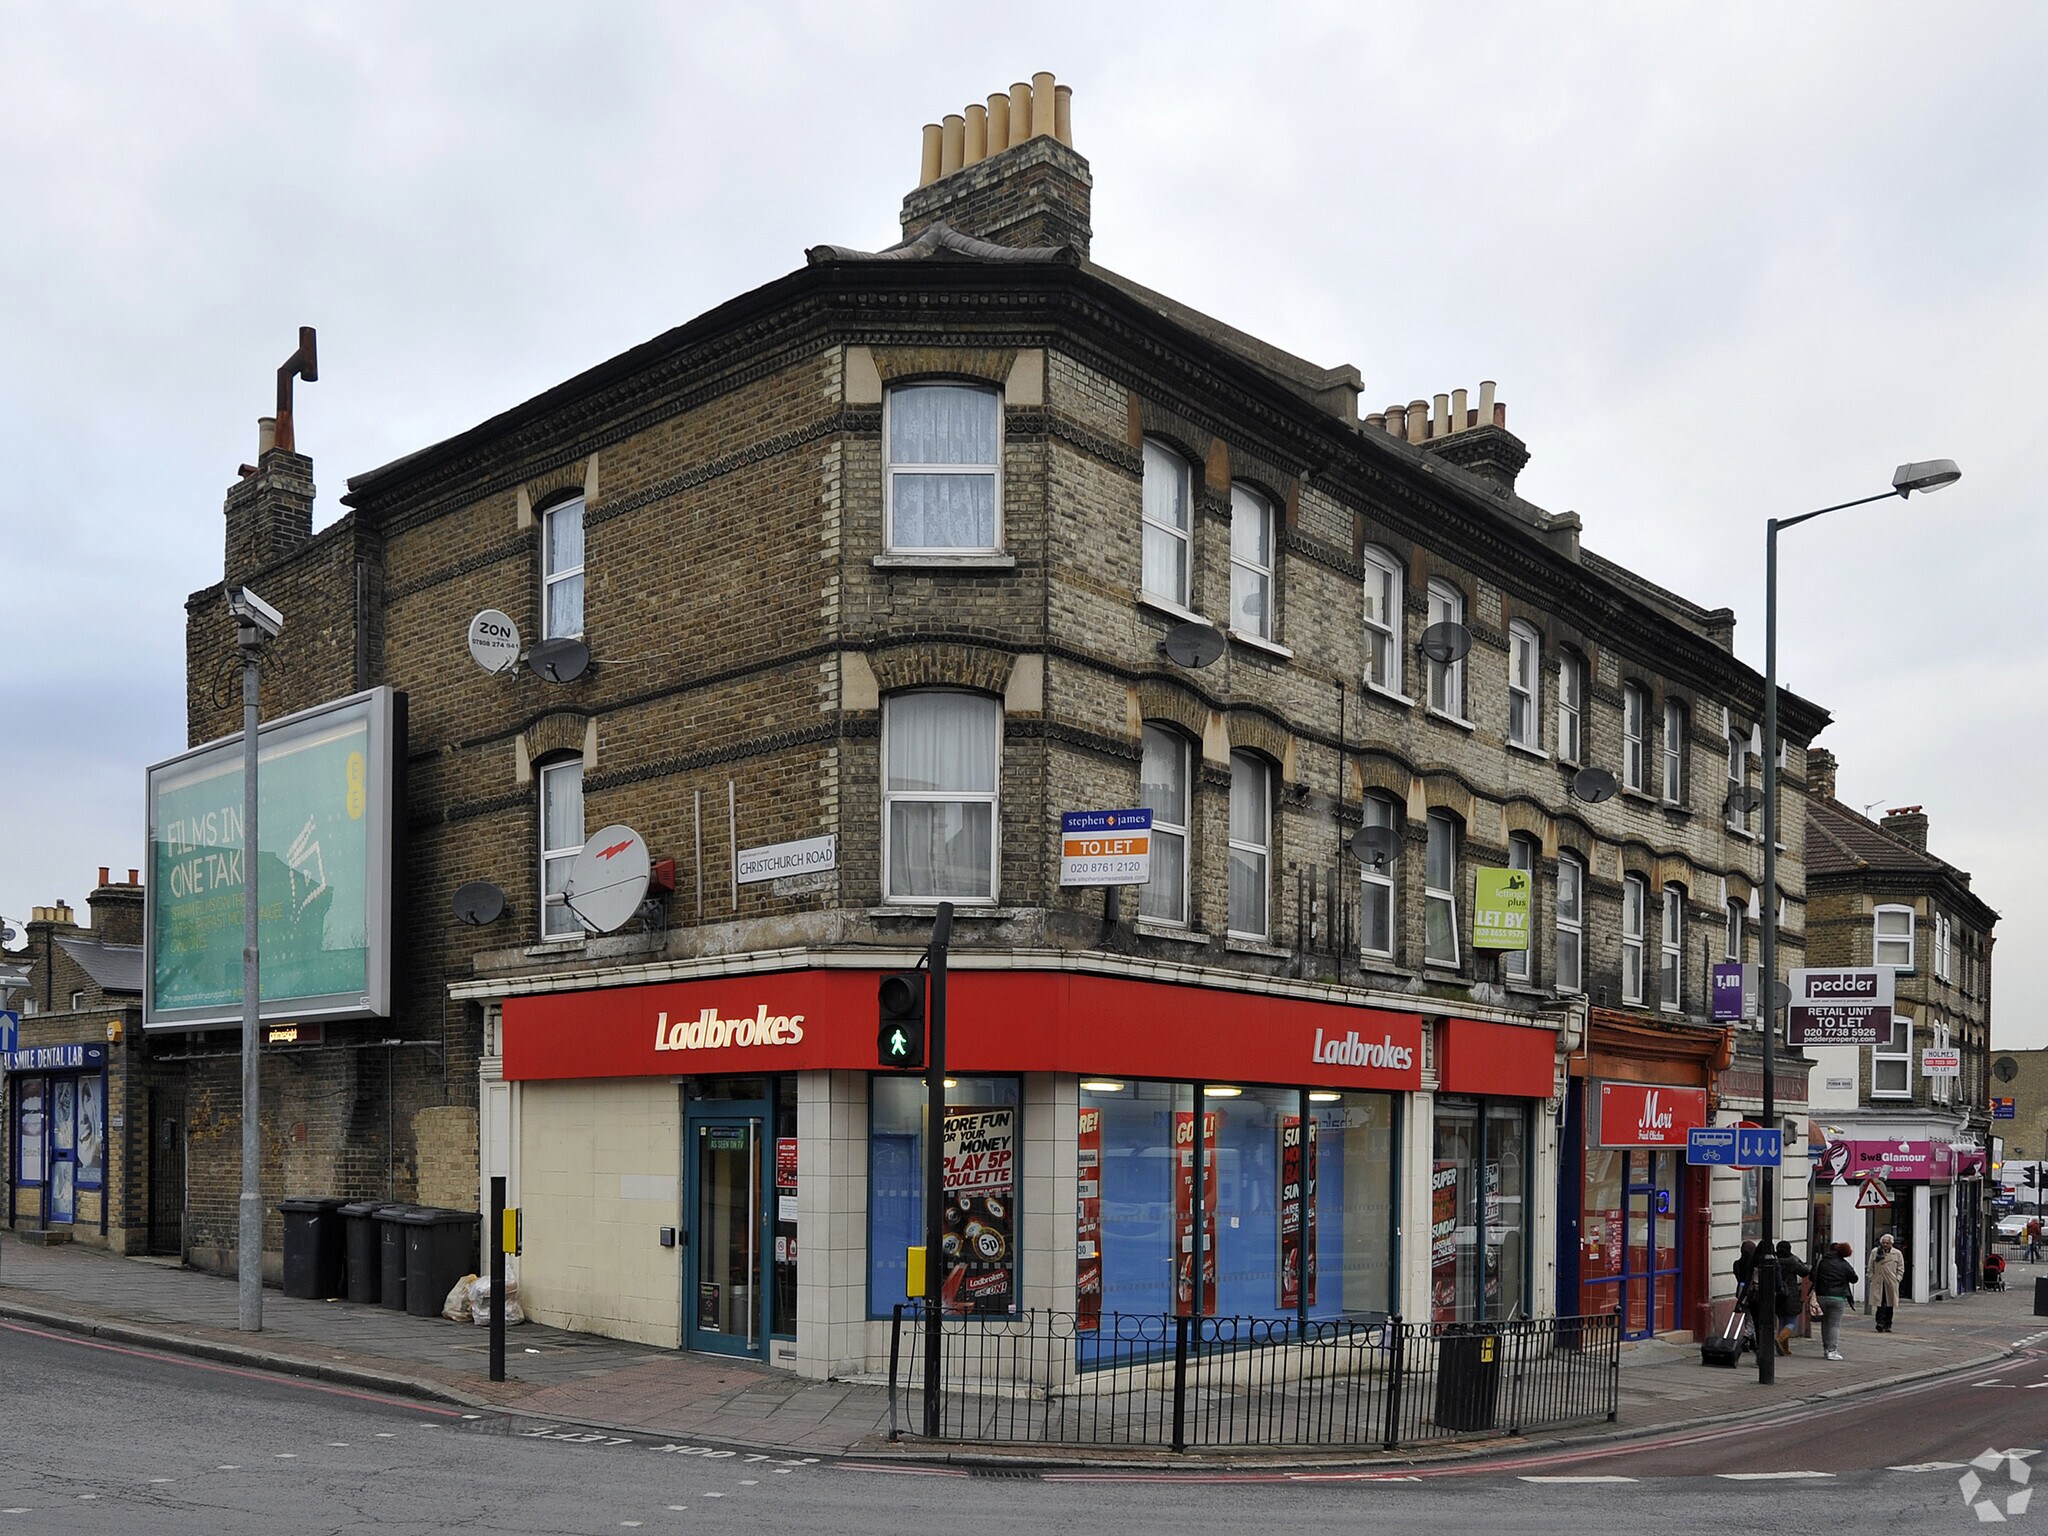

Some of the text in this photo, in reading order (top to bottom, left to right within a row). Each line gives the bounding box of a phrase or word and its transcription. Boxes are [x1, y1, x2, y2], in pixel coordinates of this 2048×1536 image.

[479, 622, 511, 639] ZON
[1068, 815, 1105, 828] stephen
[1117, 814, 1146, 826] james
[167, 804, 244, 858] FILMS IN
[1080, 840, 1133, 855] TO LET
[739, 848, 833, 875] CHRISTCHURCH ROAD
[1070, 861, 1140, 873] 020 8761 2120
[170, 858, 203, 898] ONE
[1508, 898, 1526, 908] plus
[1477, 911, 1526, 928] LET BY
[1810, 973, 1873, 998] pedder
[1808, 1007, 1874, 1016] RETAIL UNIT
[655, 1004, 805, 1051] Ladbrokes
[1816, 1017, 1864, 1028] TO LET
[1804, 1028, 1876, 1037] 020 7738 5926
[14, 1050, 35, 1069] SMILE
[38, 1047, 65, 1067] DENTAL
[68, 1046, 84, 1065] LAB
[1312, 1028, 1413, 1070] Ladbrokes
[1638, 1089, 1673, 1129] Mori
[980, 1112, 1010, 1128] FUN
[960, 1129, 986, 1140] YOUR
[1177, 1116, 1215, 1144] GOL!
[959, 1136, 1011, 1155] MONEY
[988, 1149, 1011, 1169] 5P
[1433, 1168, 1456, 1190] SUPER
[981, 1237, 998, 1252] 5p
[969, 1271, 1005, 1288] Ladbrokes
[518, 1428, 769, 1462] LOOK LEFT
